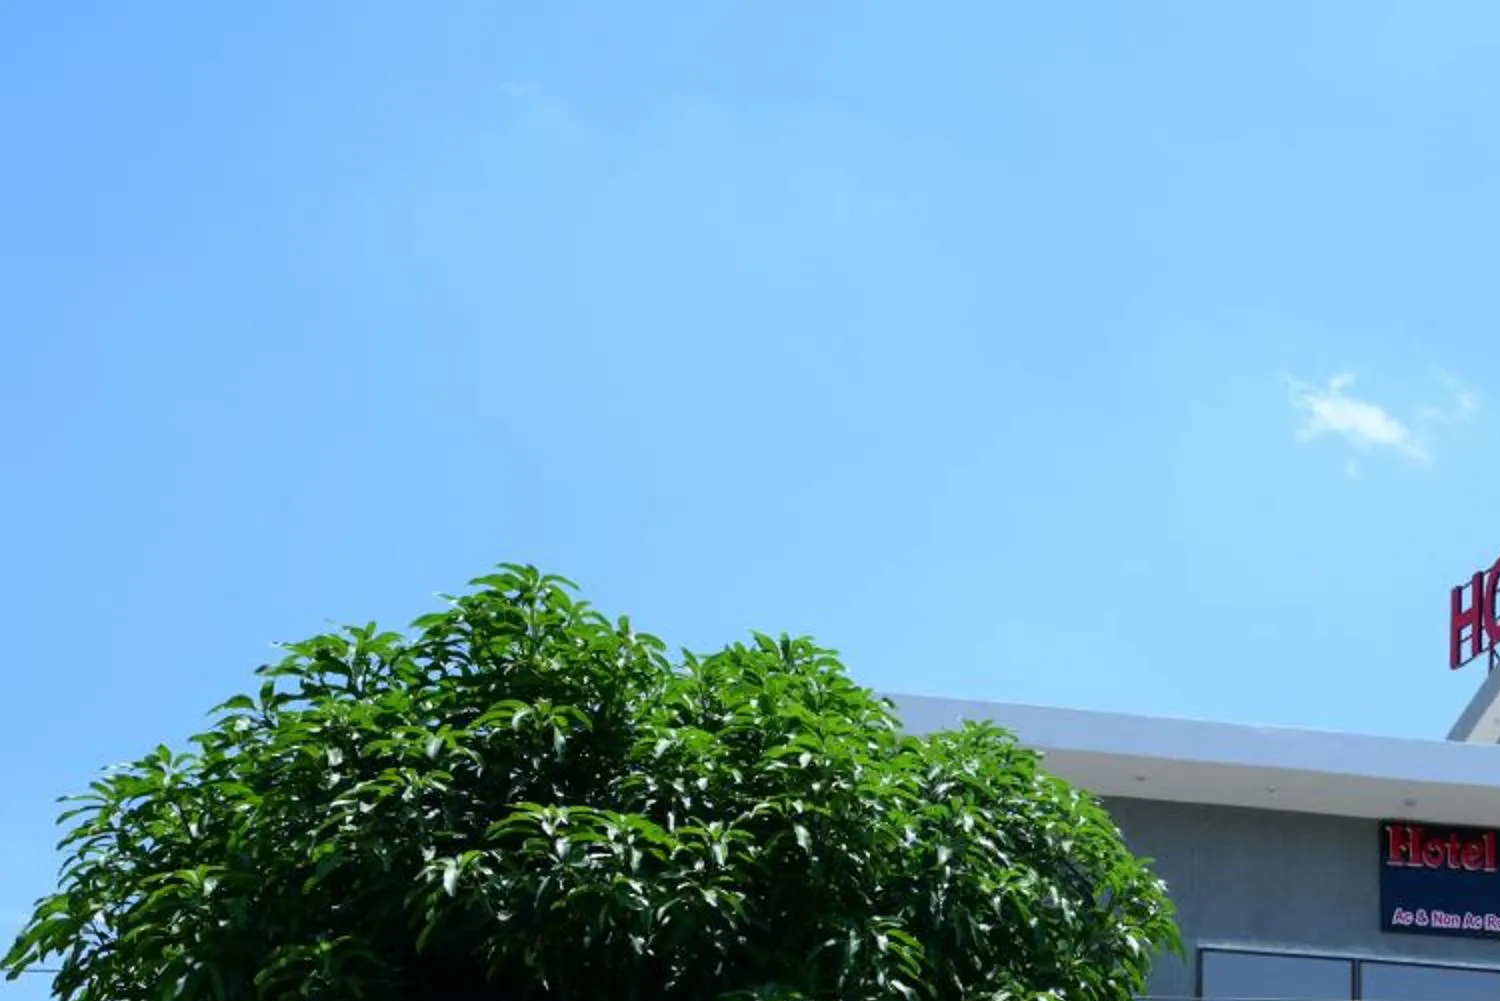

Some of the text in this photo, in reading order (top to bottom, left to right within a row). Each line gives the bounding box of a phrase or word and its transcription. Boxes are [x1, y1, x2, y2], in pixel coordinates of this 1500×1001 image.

[1386, 824, 1498, 872] Hotel
[1415, 909, 1429, 926] &
[1431, 909, 1460, 929] Non
